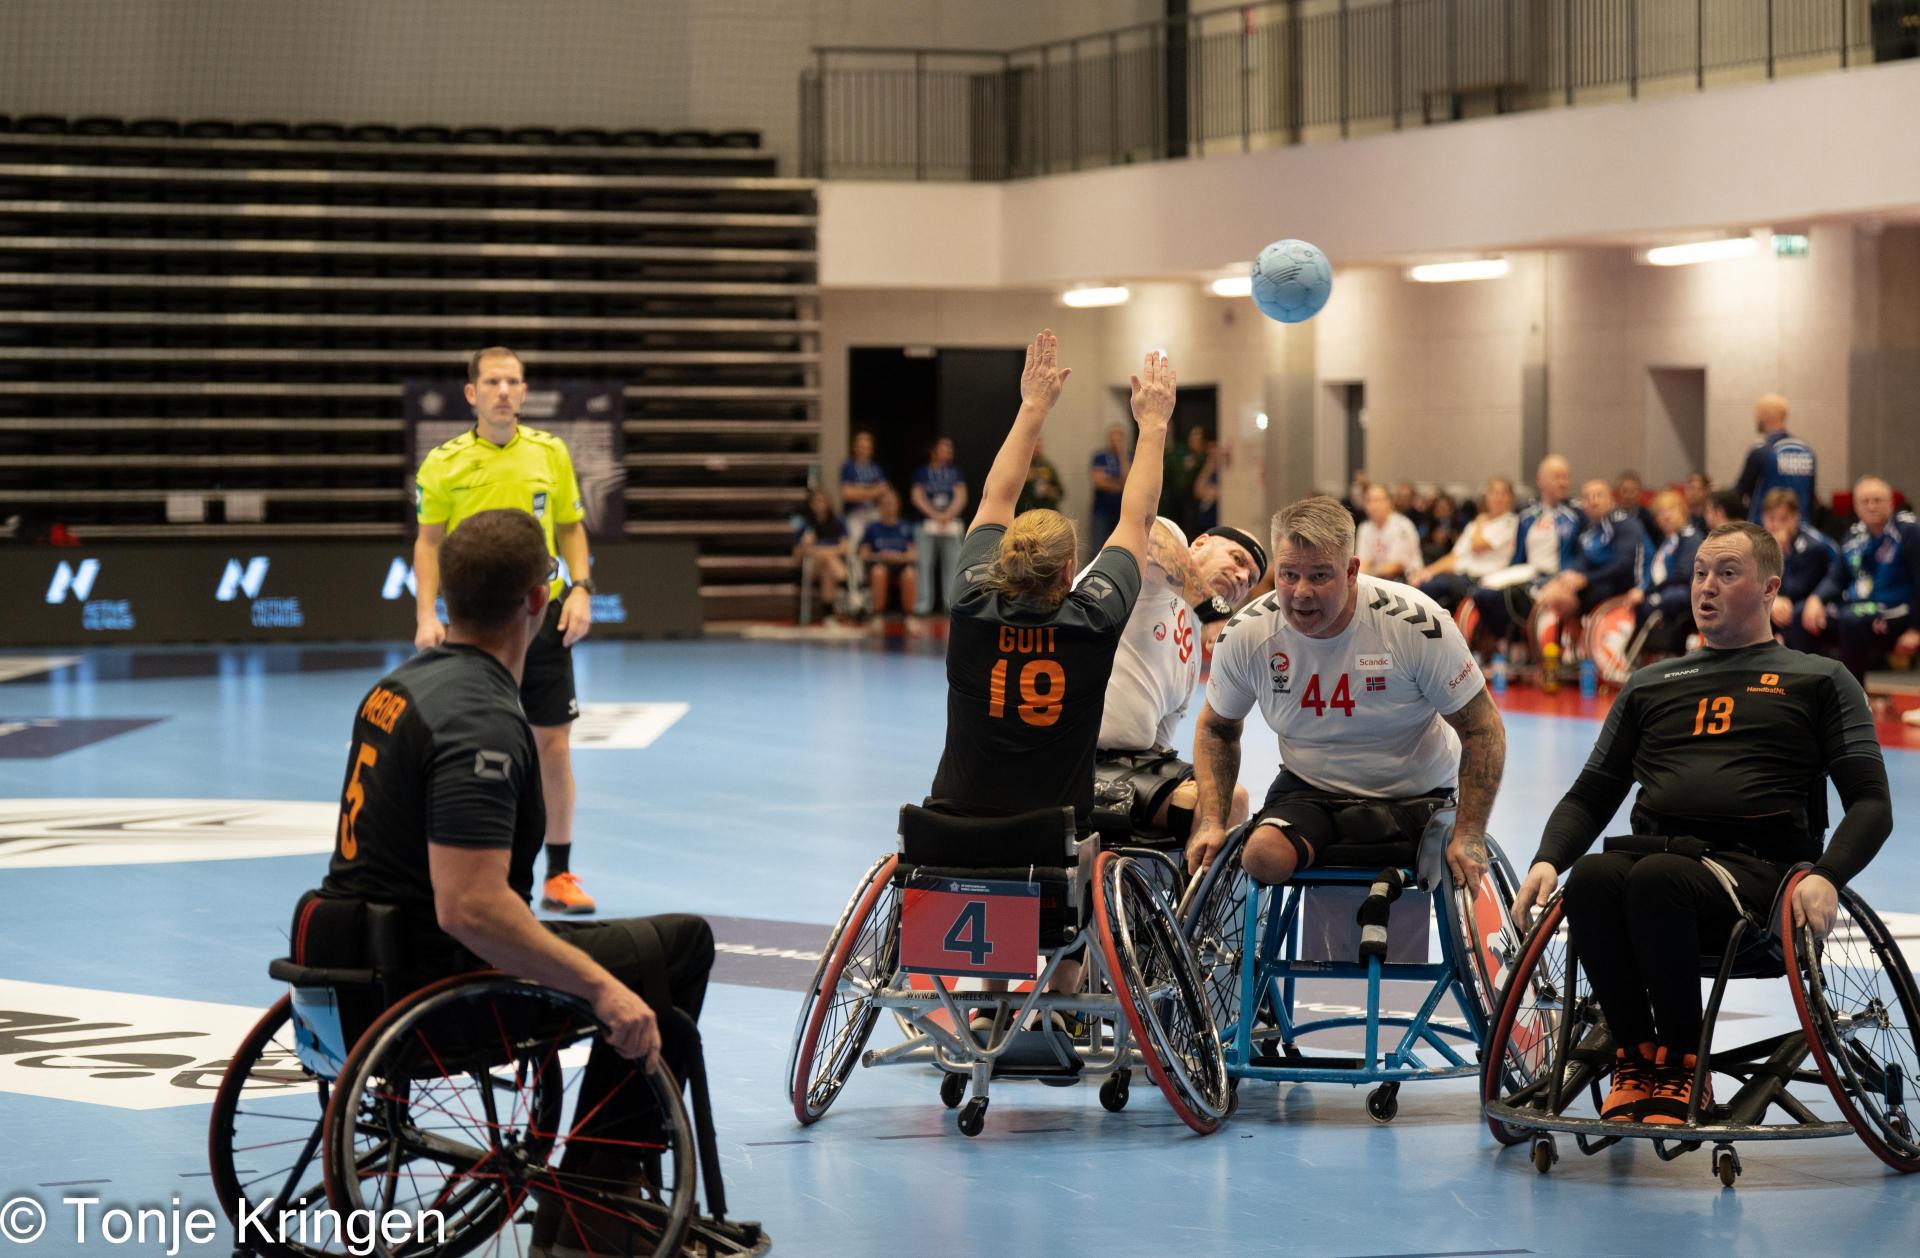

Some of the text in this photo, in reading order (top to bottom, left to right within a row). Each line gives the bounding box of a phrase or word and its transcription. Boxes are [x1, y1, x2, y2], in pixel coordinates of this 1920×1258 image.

[1359, 657, 1388, 666] Scandic
[989, 658, 1065, 727] 19
[1301, 672, 1355, 717] 44
[1692, 696, 1734, 736] 13
[341, 742, 378, 861] 5
[943, 901, 994, 966] 4
